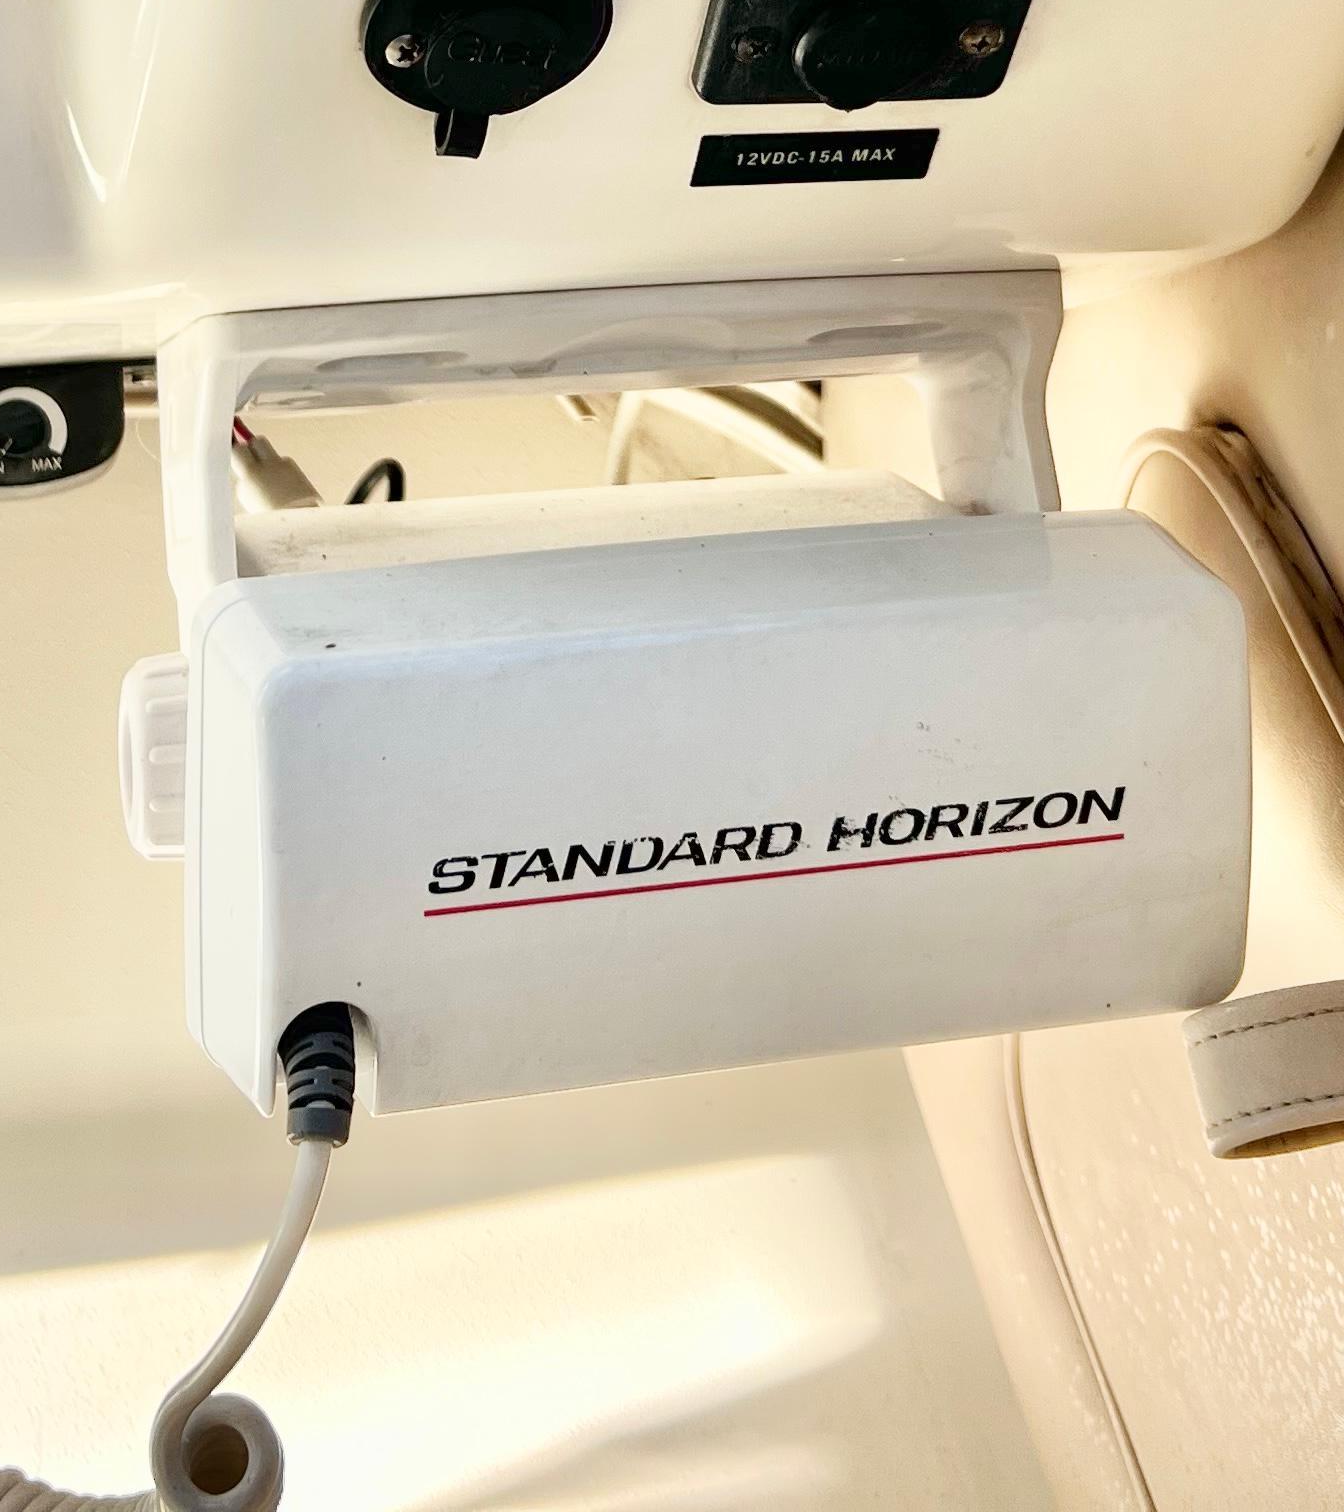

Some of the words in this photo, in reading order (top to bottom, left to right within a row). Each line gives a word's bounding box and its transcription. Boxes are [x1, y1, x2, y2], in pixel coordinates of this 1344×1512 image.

[736, 150, 844, 167] 12VDC-15A
[851, 147, 897, 162] MAX
[31, 456, 63, 472] MAX
[426, 820, 803, 896] STANDARD
[825, 786, 1126, 852] HORIZON
